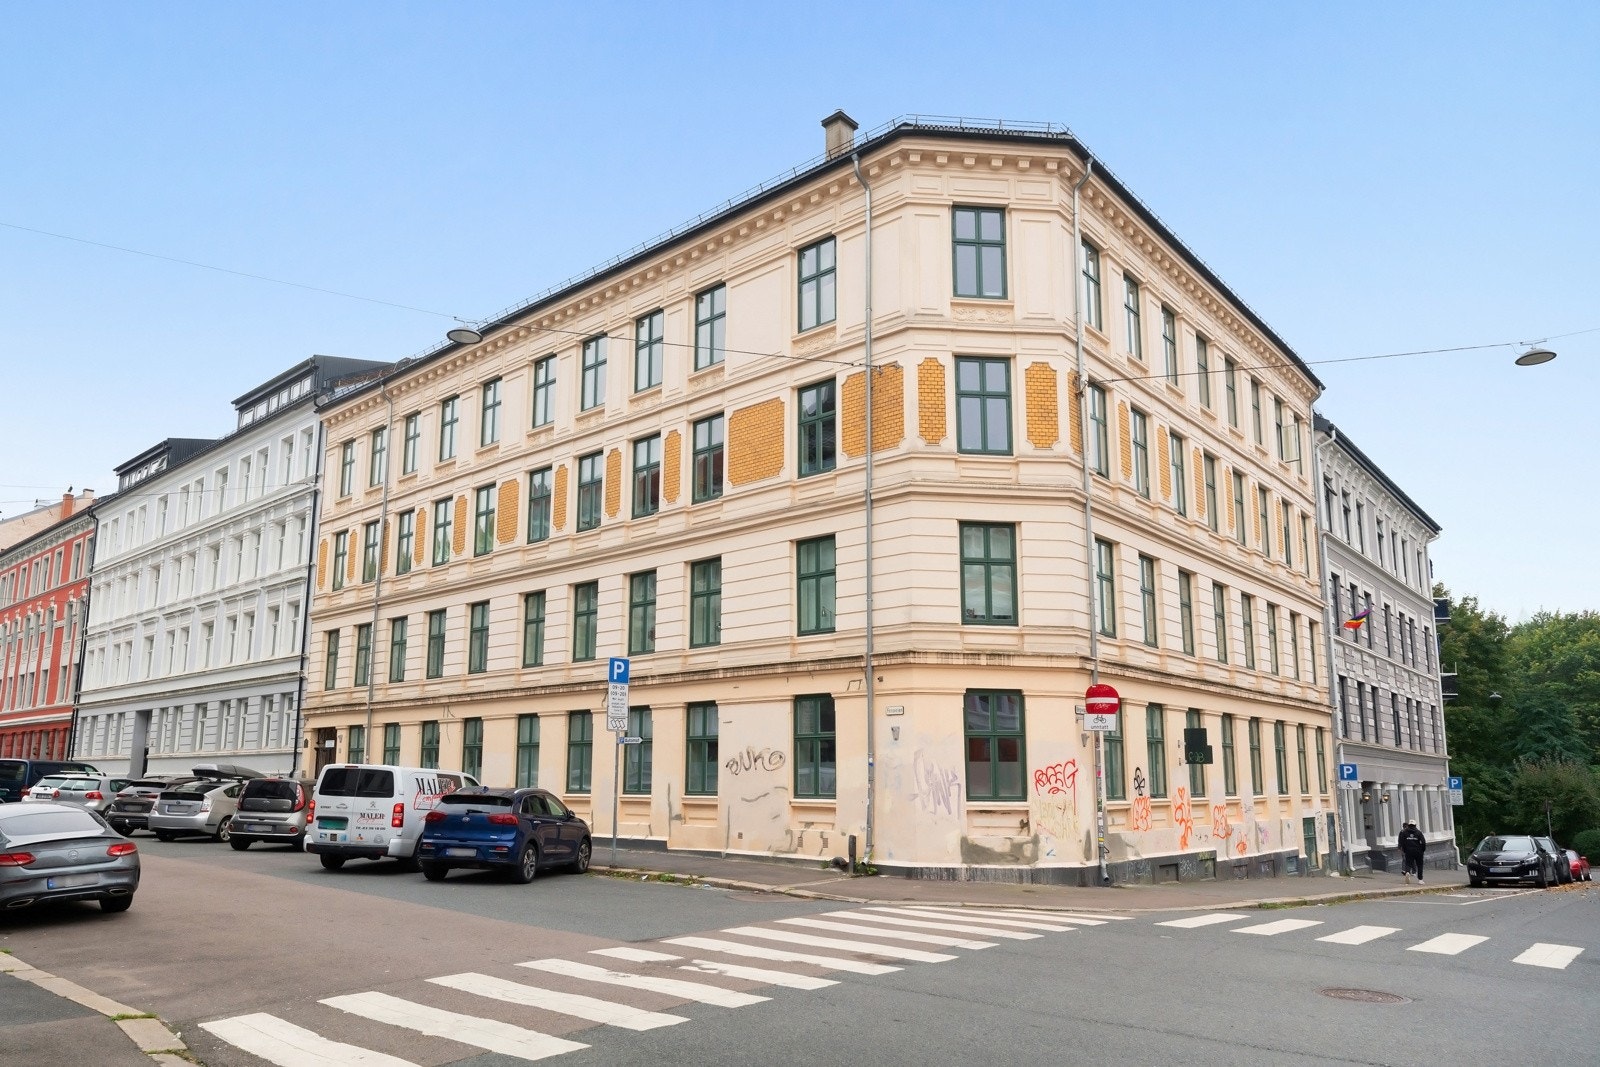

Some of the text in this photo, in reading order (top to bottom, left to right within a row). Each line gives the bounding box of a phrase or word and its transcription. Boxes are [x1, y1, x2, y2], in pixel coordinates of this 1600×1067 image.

[613, 660, 625, 680] P
[1343, 765, 1353, 779] P
[1451, 778, 1459, 788] P
